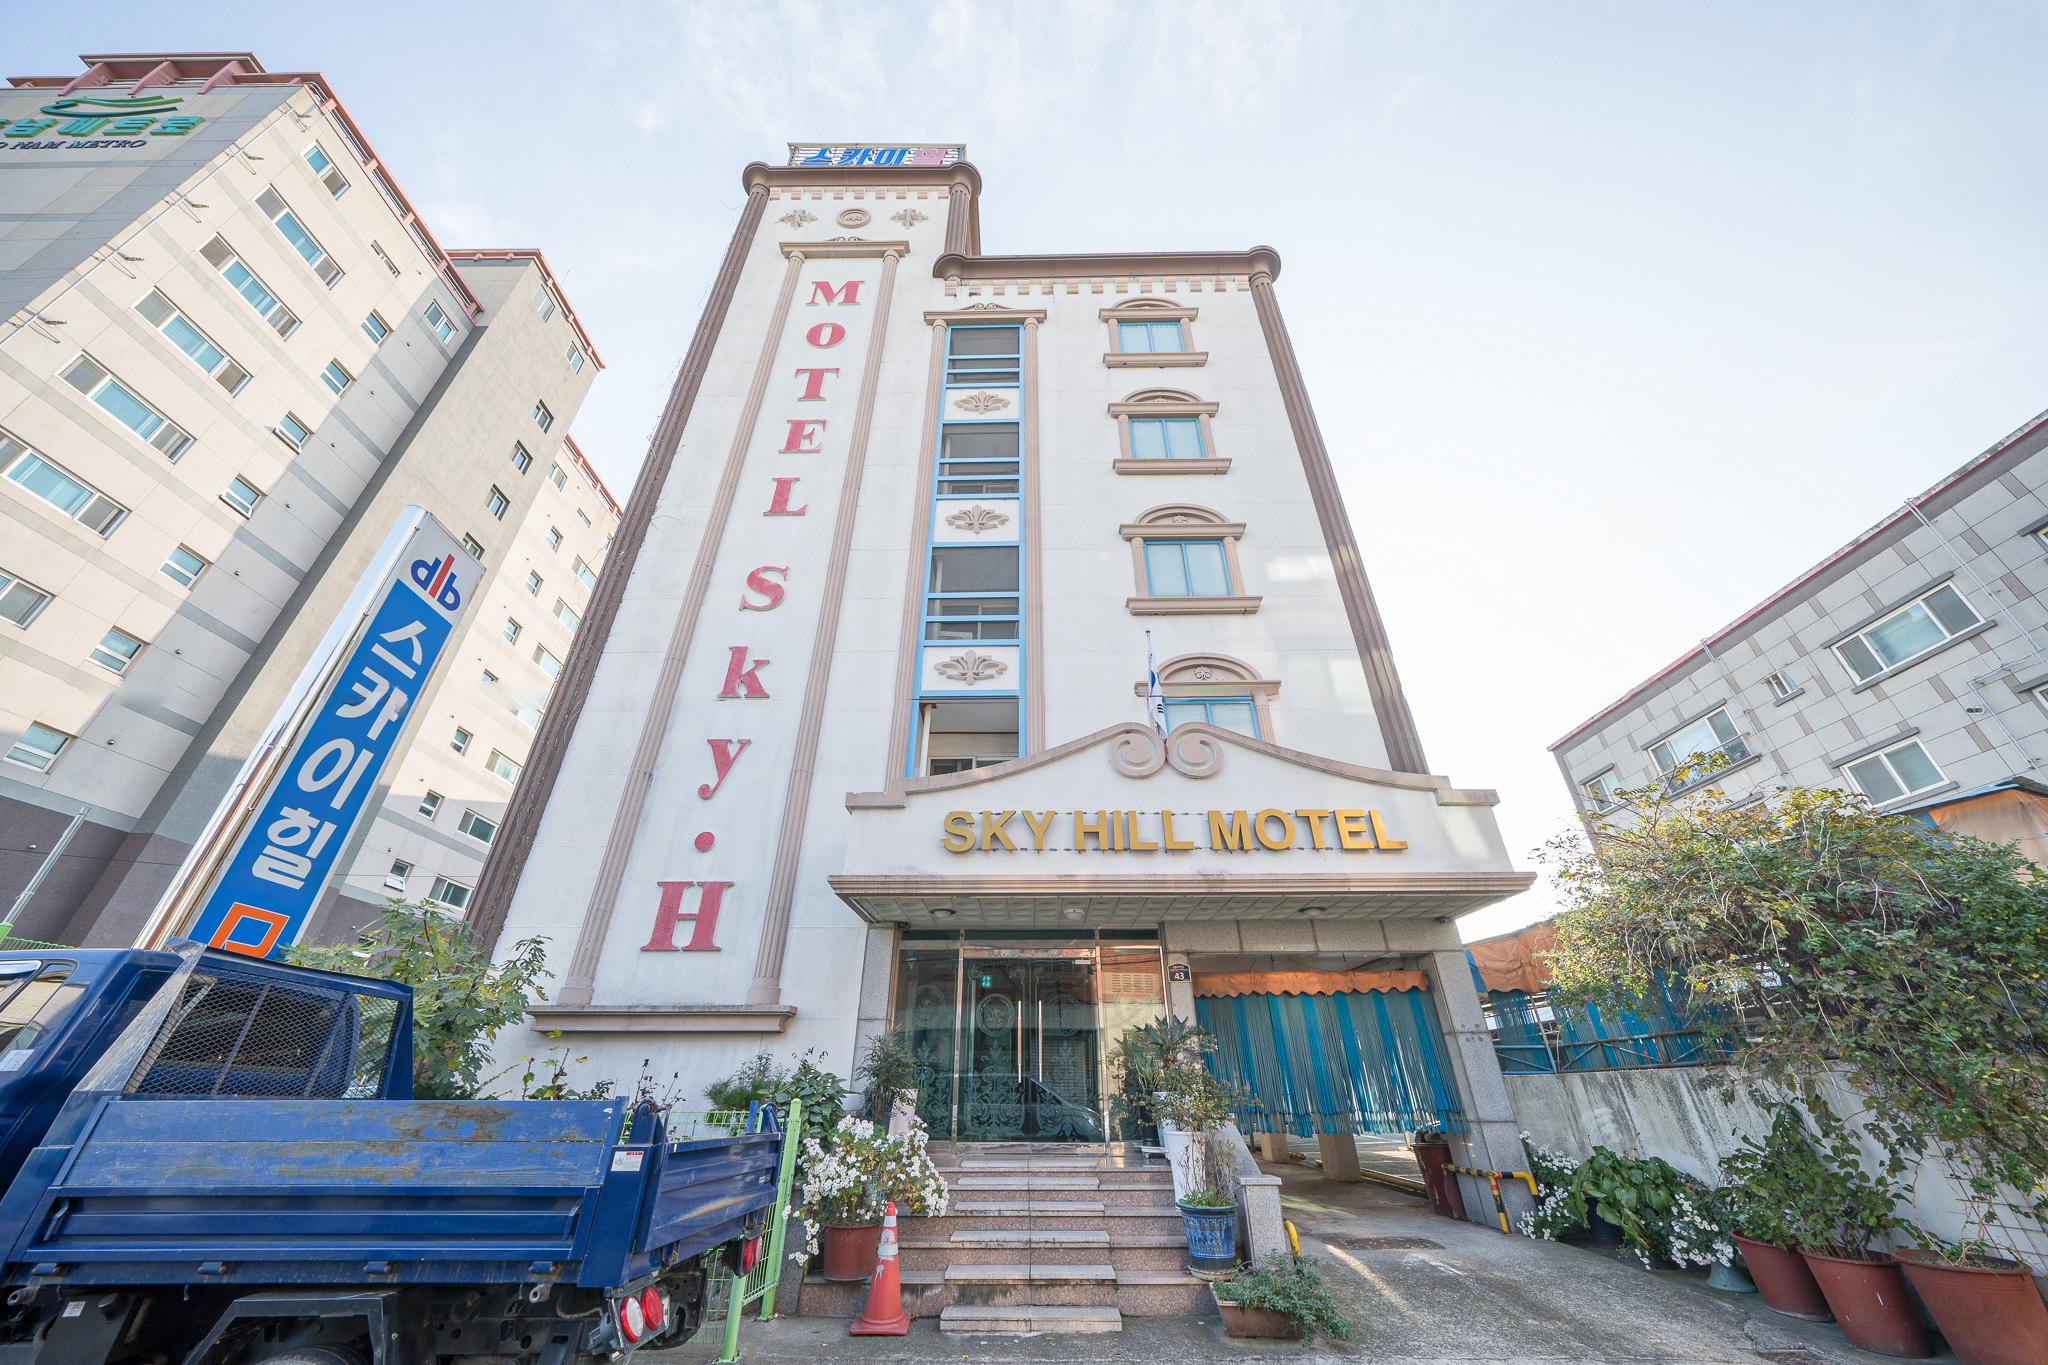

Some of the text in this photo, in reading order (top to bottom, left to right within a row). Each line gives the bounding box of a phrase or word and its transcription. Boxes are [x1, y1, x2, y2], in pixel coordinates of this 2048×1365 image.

[0, 116, 205, 138] 남메트로
[9, 141, 66, 149] NAM
[65, 139, 147, 149] METRO
[763, 280, 865, 516] MOTEL
[251, 620, 428, 890] 스카이힐
[940, 808, 1409, 852] SKY HILL MOTEL
[1175, 972, 1185, 980] 43
